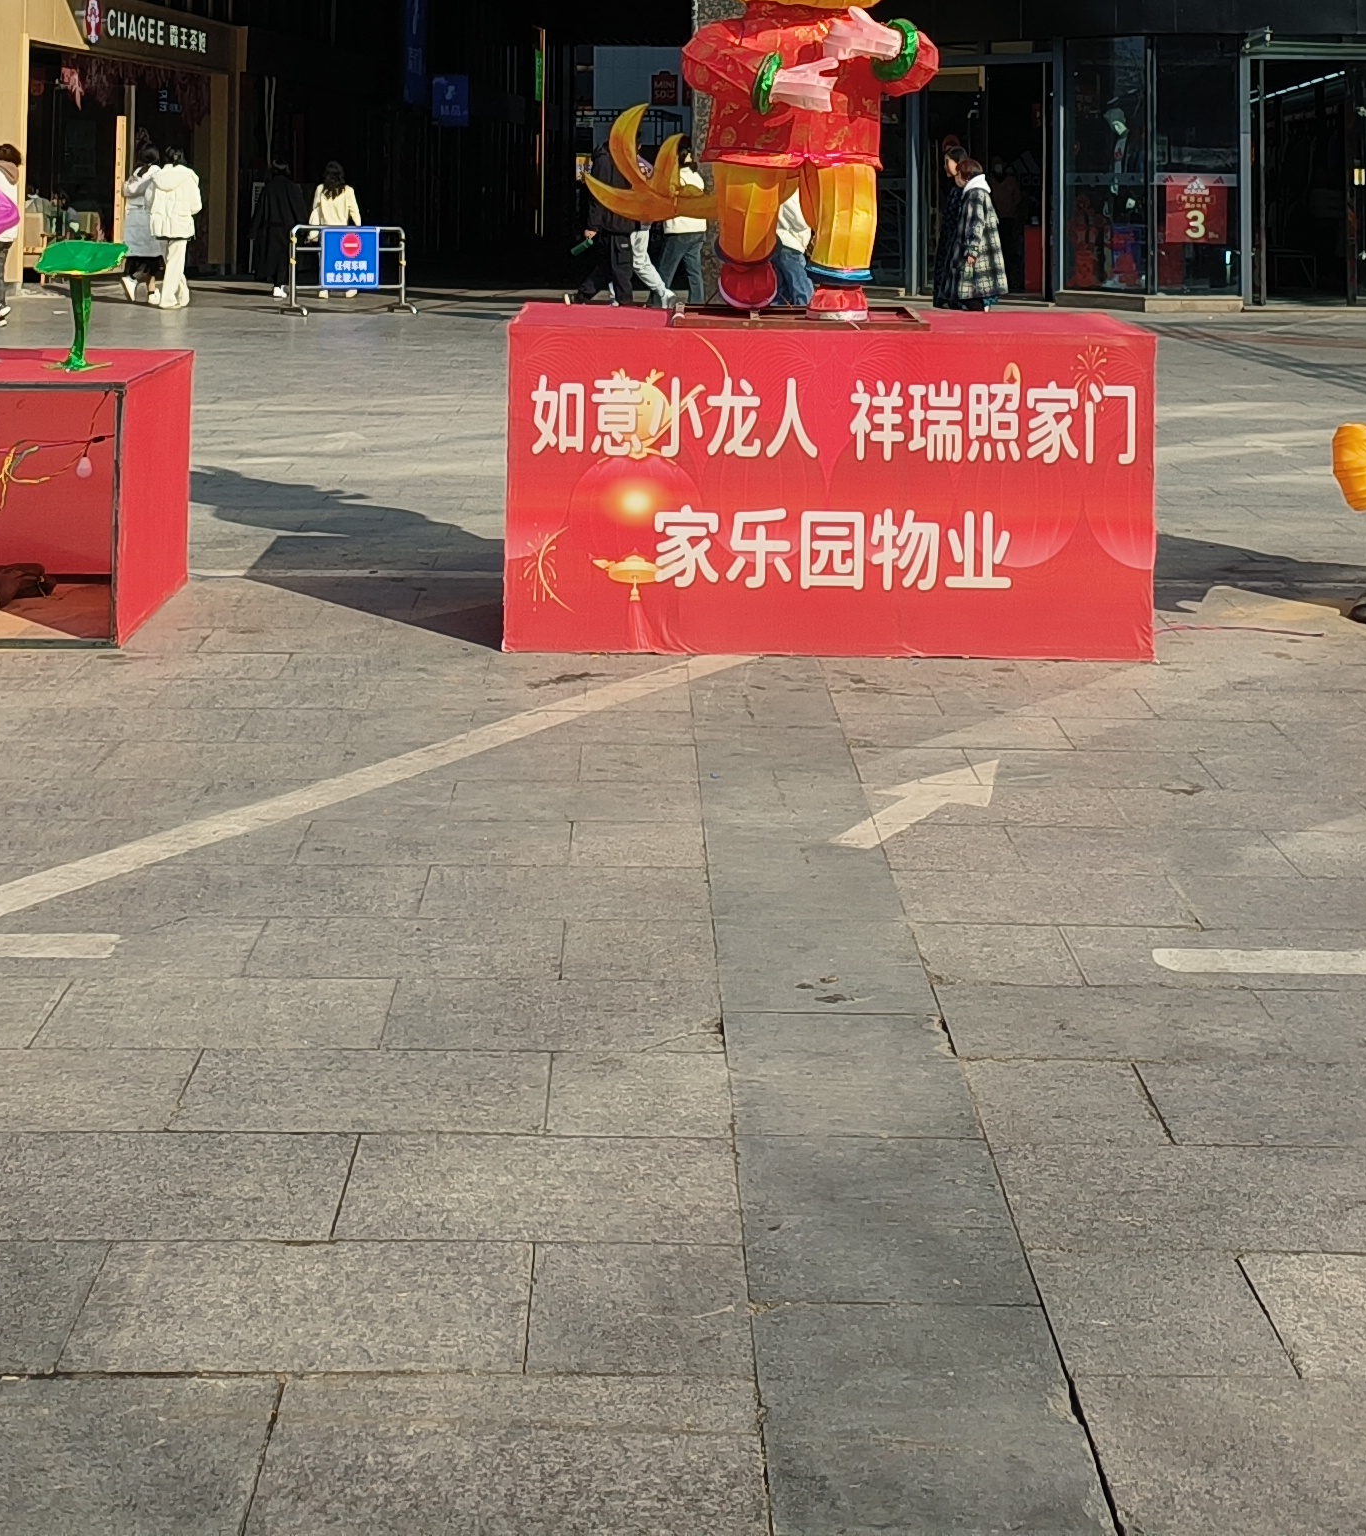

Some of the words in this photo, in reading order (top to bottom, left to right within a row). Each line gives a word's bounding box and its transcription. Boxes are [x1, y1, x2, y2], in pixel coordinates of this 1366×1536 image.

[107, 9, 164, 46] CHAGEE
[169, 24, 206, 53] 霸王茶姬
[530, 375, 818, 459] 如意小龙人
[850, 379, 1137, 465] 祥瑞照家门
[653, 505, 1012, 591] 家乐园物业
